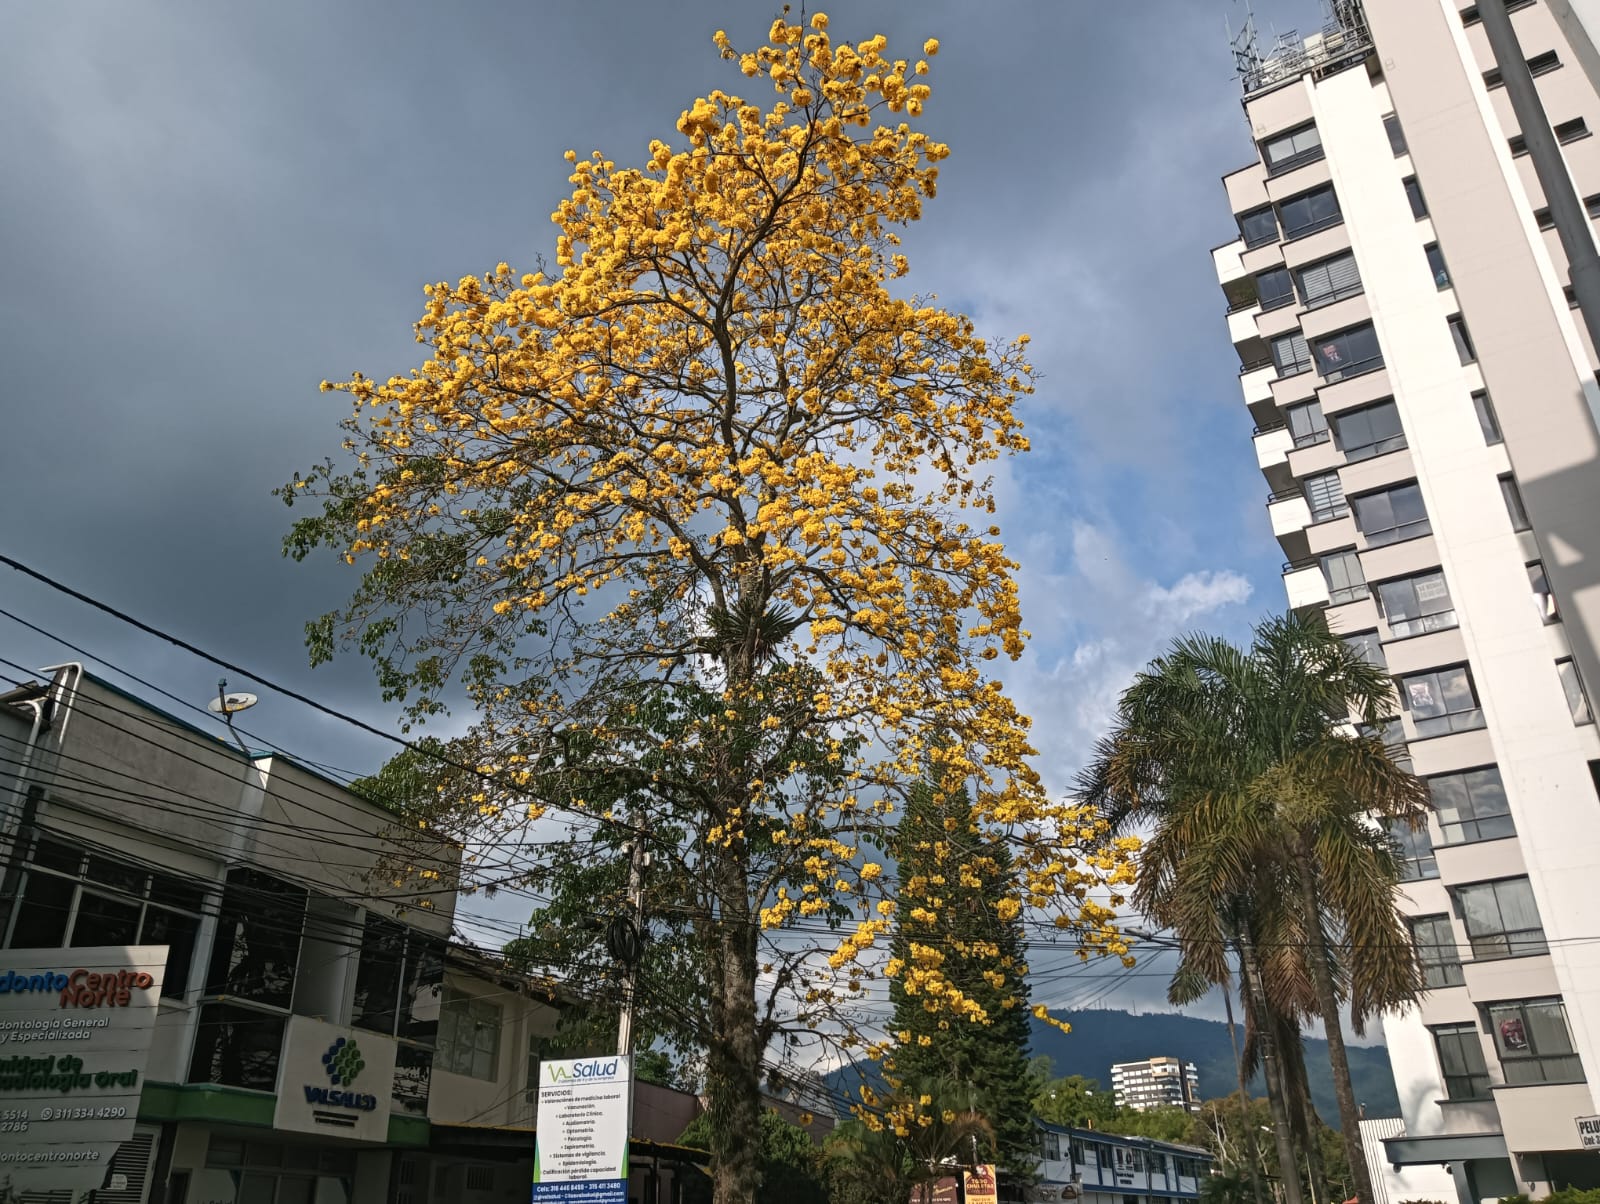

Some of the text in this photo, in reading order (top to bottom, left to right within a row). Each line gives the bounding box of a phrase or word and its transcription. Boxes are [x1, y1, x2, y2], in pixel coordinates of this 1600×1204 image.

[59, 986, 131, 1008] Norte
[63, 1017, 110, 1028] General
[1, 1030, 90, 1044] y Especializada
[57, 1054, 84, 1071] de
[95, 1069, 138, 1088] Oral
[55, 1107, 73, 1119] 311
[74, 1107, 94, 1118] 334
[97, 1106, 126, 1117] 4290
[1, 1121, 28, 1131] 2786
[1579, 1119, 1600, 1134] PELU
[0, 1149, 100, 1162] ontocentronorte
